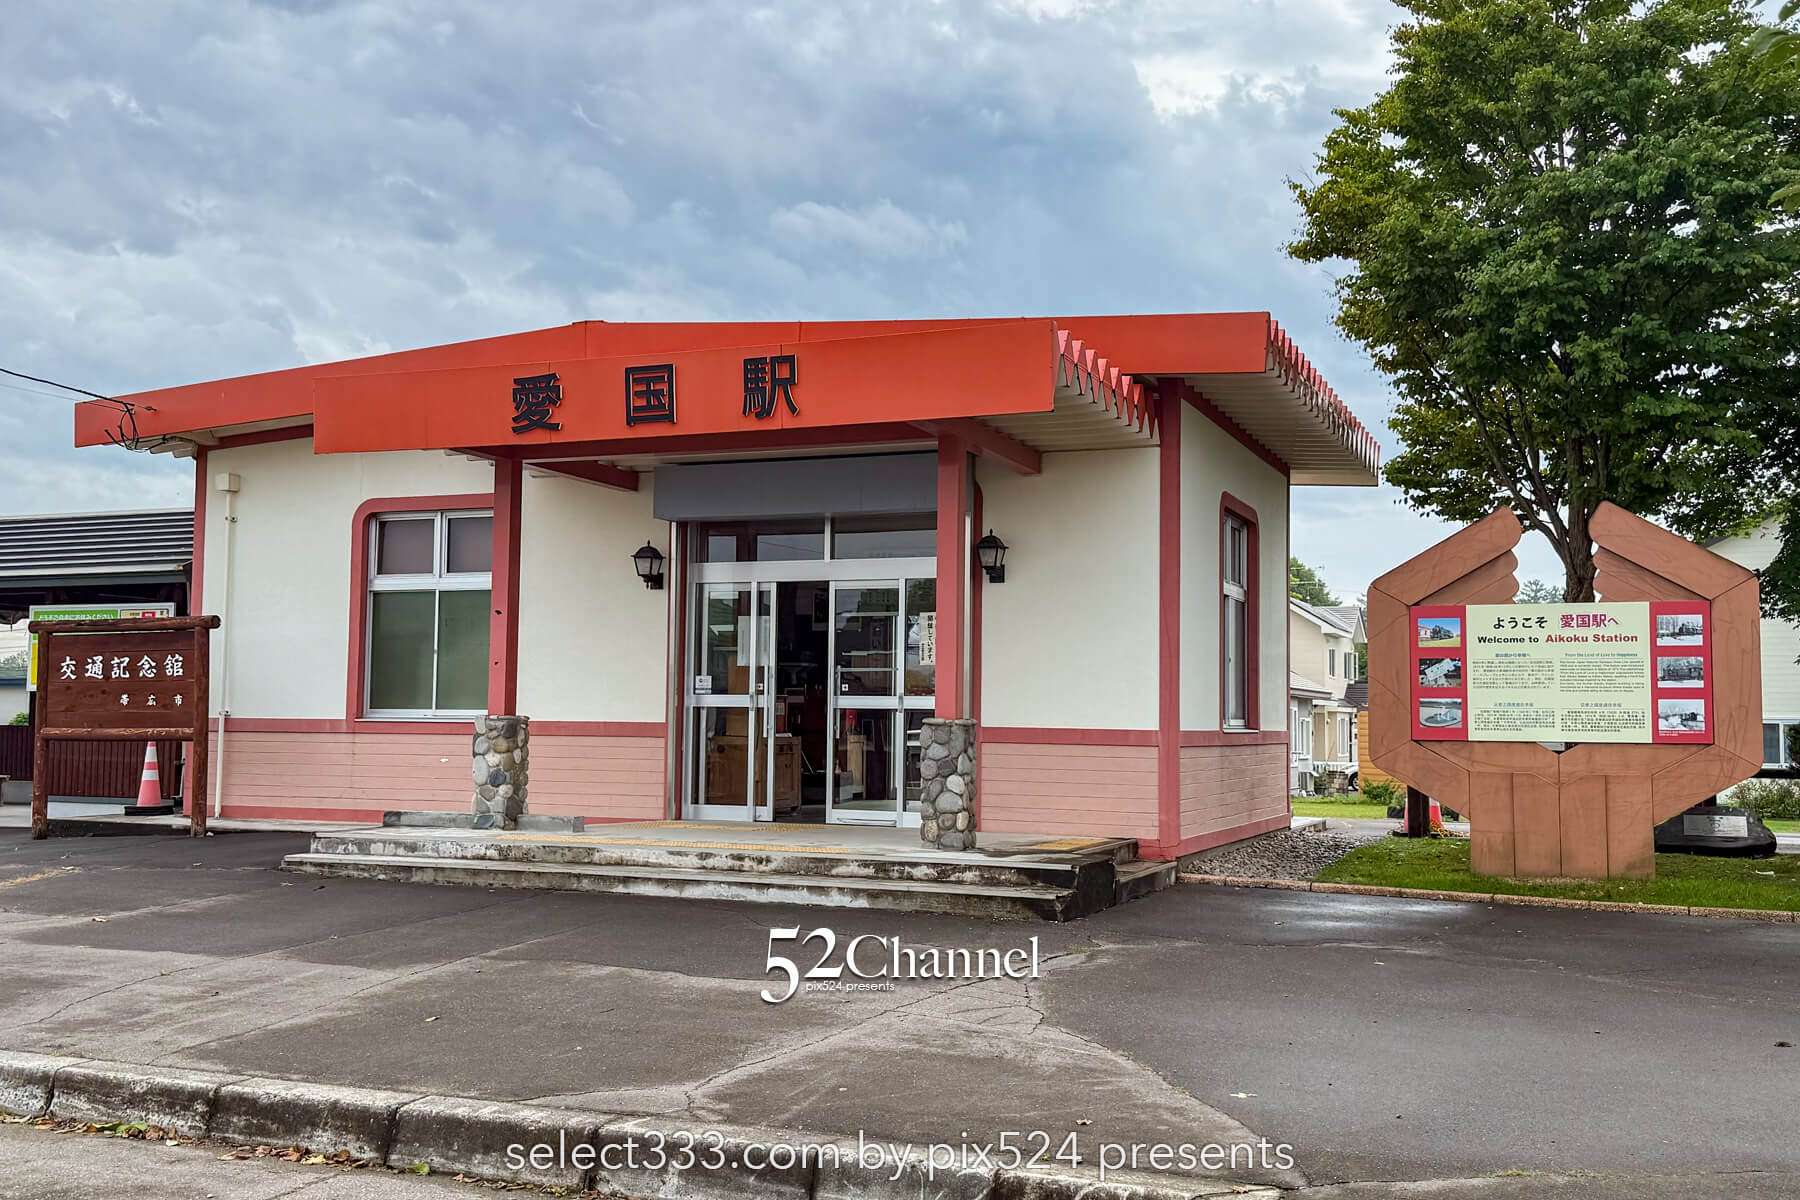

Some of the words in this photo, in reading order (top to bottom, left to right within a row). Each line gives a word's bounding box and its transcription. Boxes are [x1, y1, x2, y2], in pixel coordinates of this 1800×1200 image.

[511, 354, 800, 435] 愛国駅
[1493, 616, 1548, 630] ようこそ
[1560, 614, 1619, 629] 愛国駅へ
[1477, 635, 1526, 644] Welcome
[1528, 636, 1540, 644] to
[1545, 634, 1589, 643] Aikoku
[1592, 633, 1639, 643] Station
[119, 694, 184, 707] 帯広市
